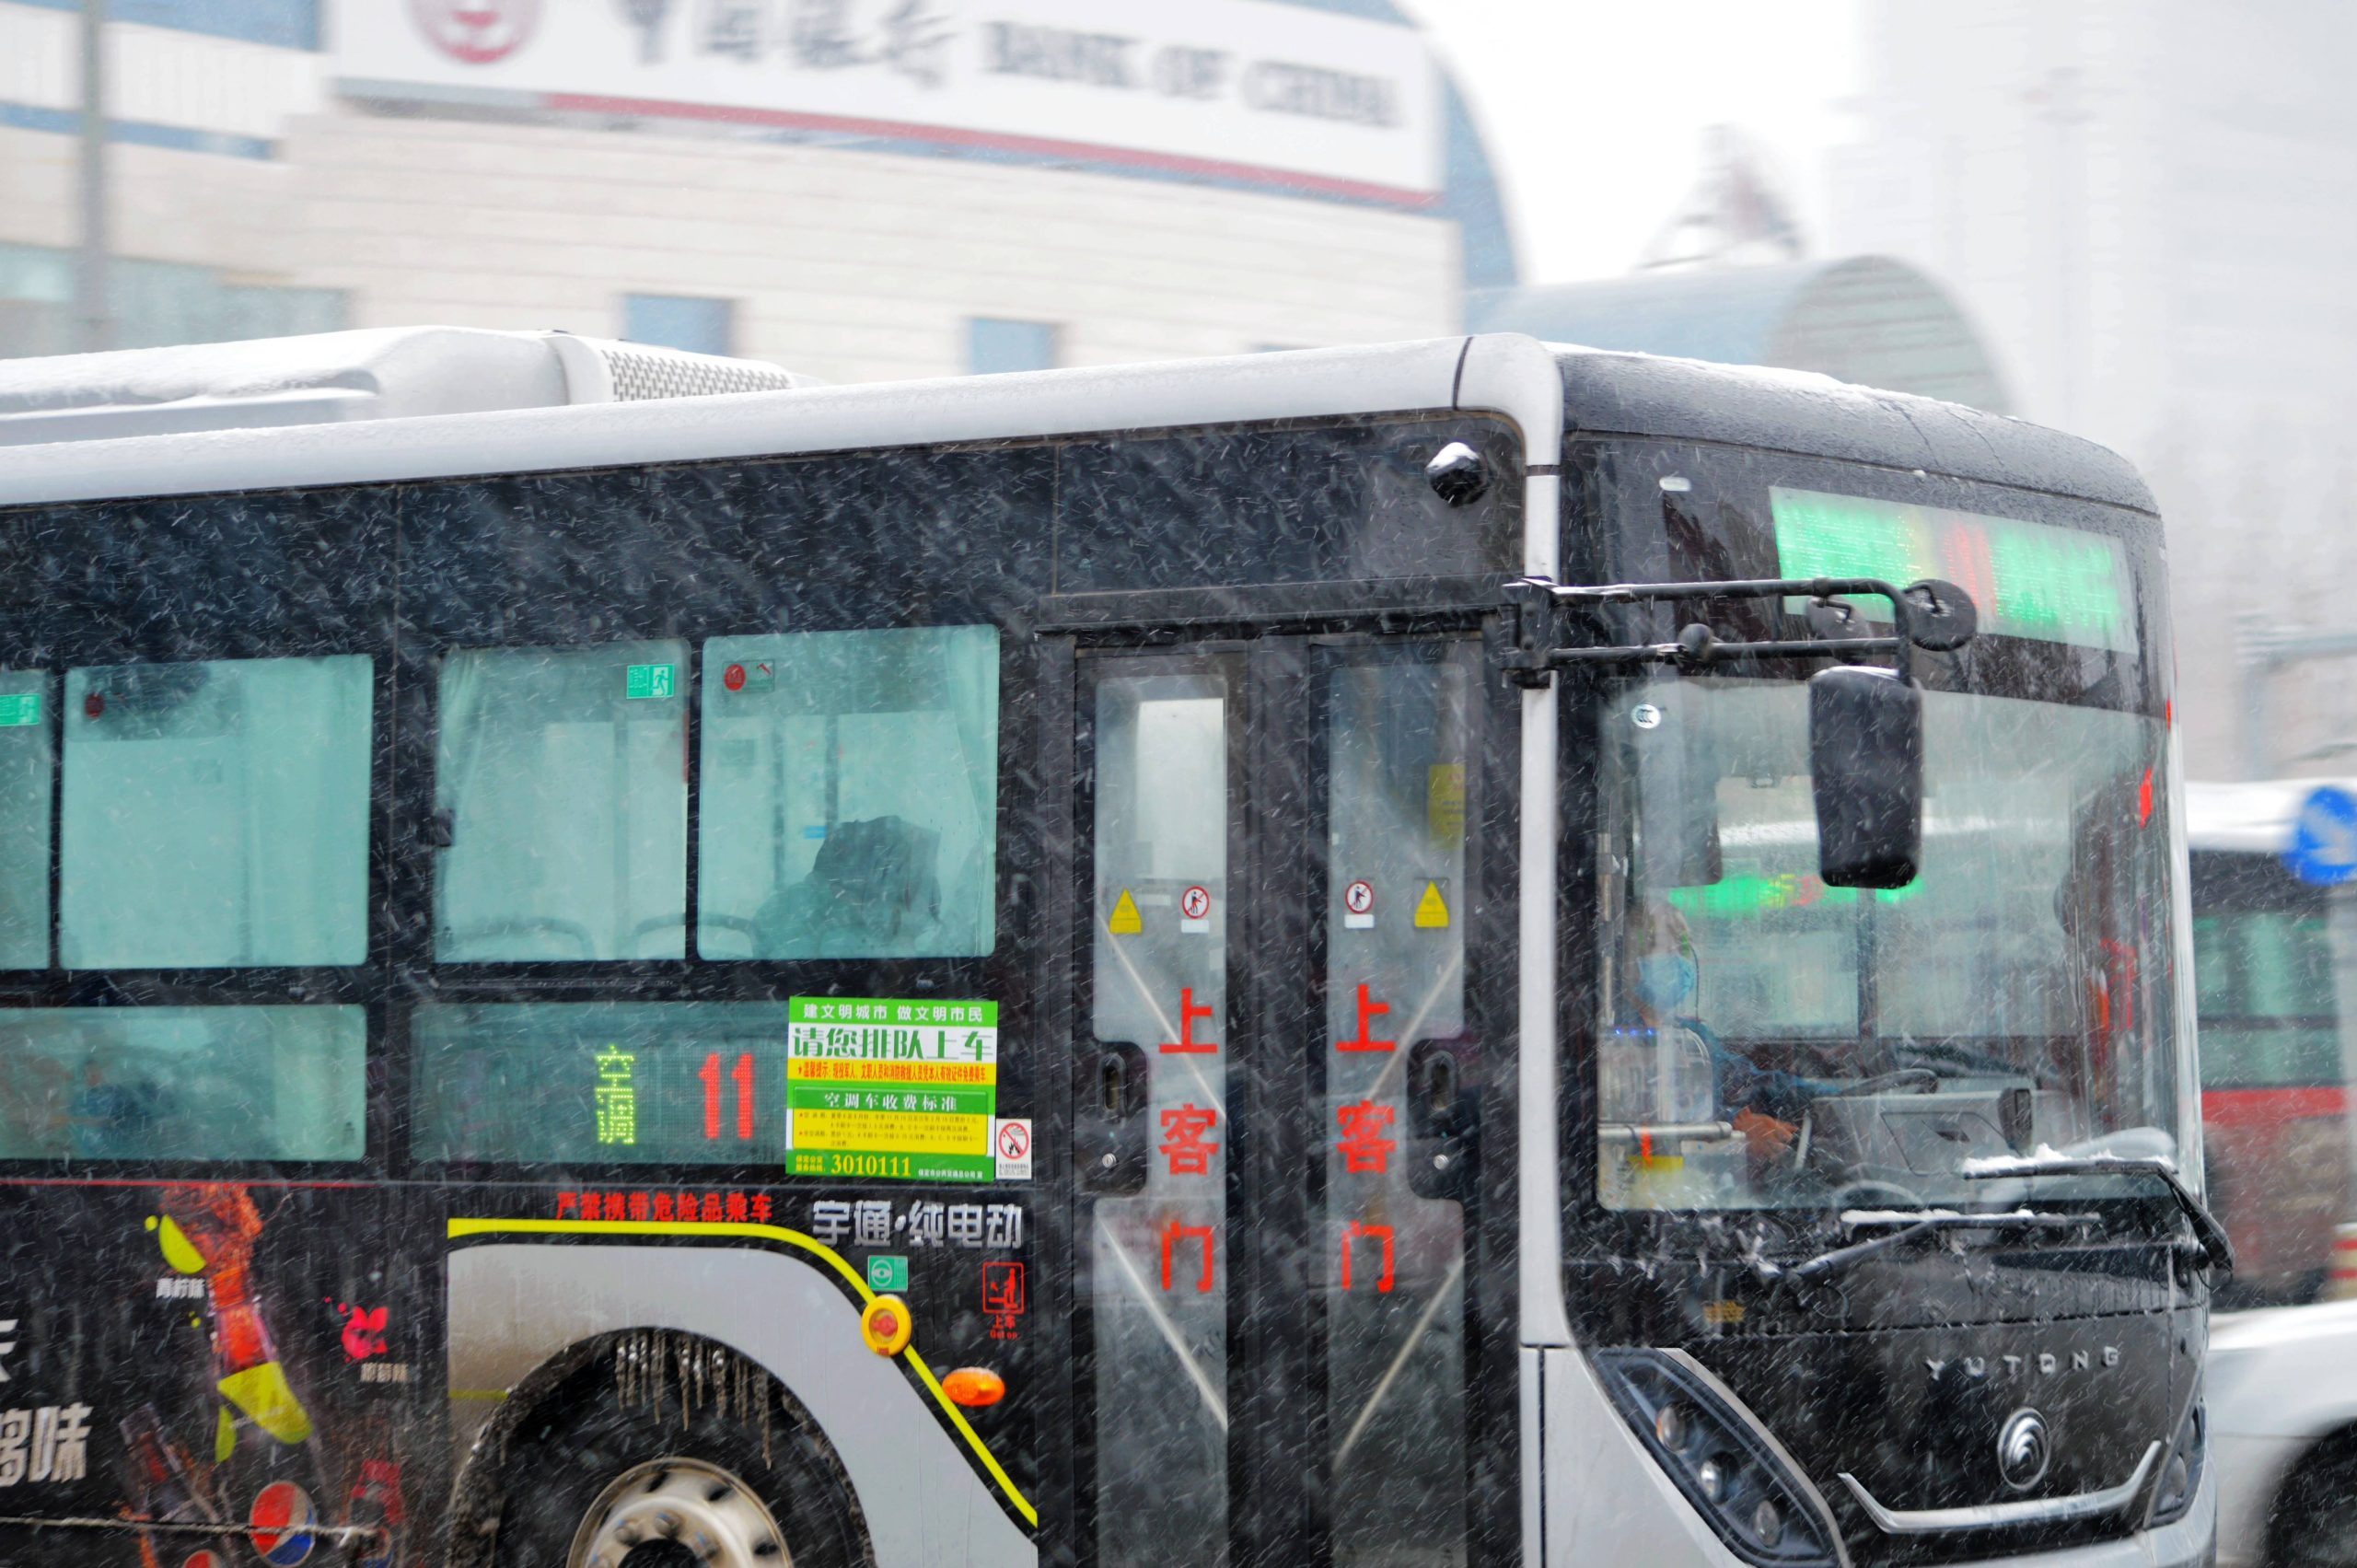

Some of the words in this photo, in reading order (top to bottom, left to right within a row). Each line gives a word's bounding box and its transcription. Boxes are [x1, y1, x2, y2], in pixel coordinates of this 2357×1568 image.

[804, 1004, 888, 1020] 建文明城市
[897, 1005, 982, 1023] 做文明市民
[792, 1027, 993, 1062] 请您排队上车
[595, 1044, 635, 1144] 空调
[698, 1052, 754, 1140] 11
[825, 1092, 957, 1111] 空调车收费标准
[1159, 987, 1219, 1294] 上客门
[1338, 983, 1397, 1294] 上客门
[830, 1154, 911, 1177] 3010111
[556, 1191, 772, 1223] 严禁携带危险品乘车
[1923, 1345, 2119, 1381] YUTONG
